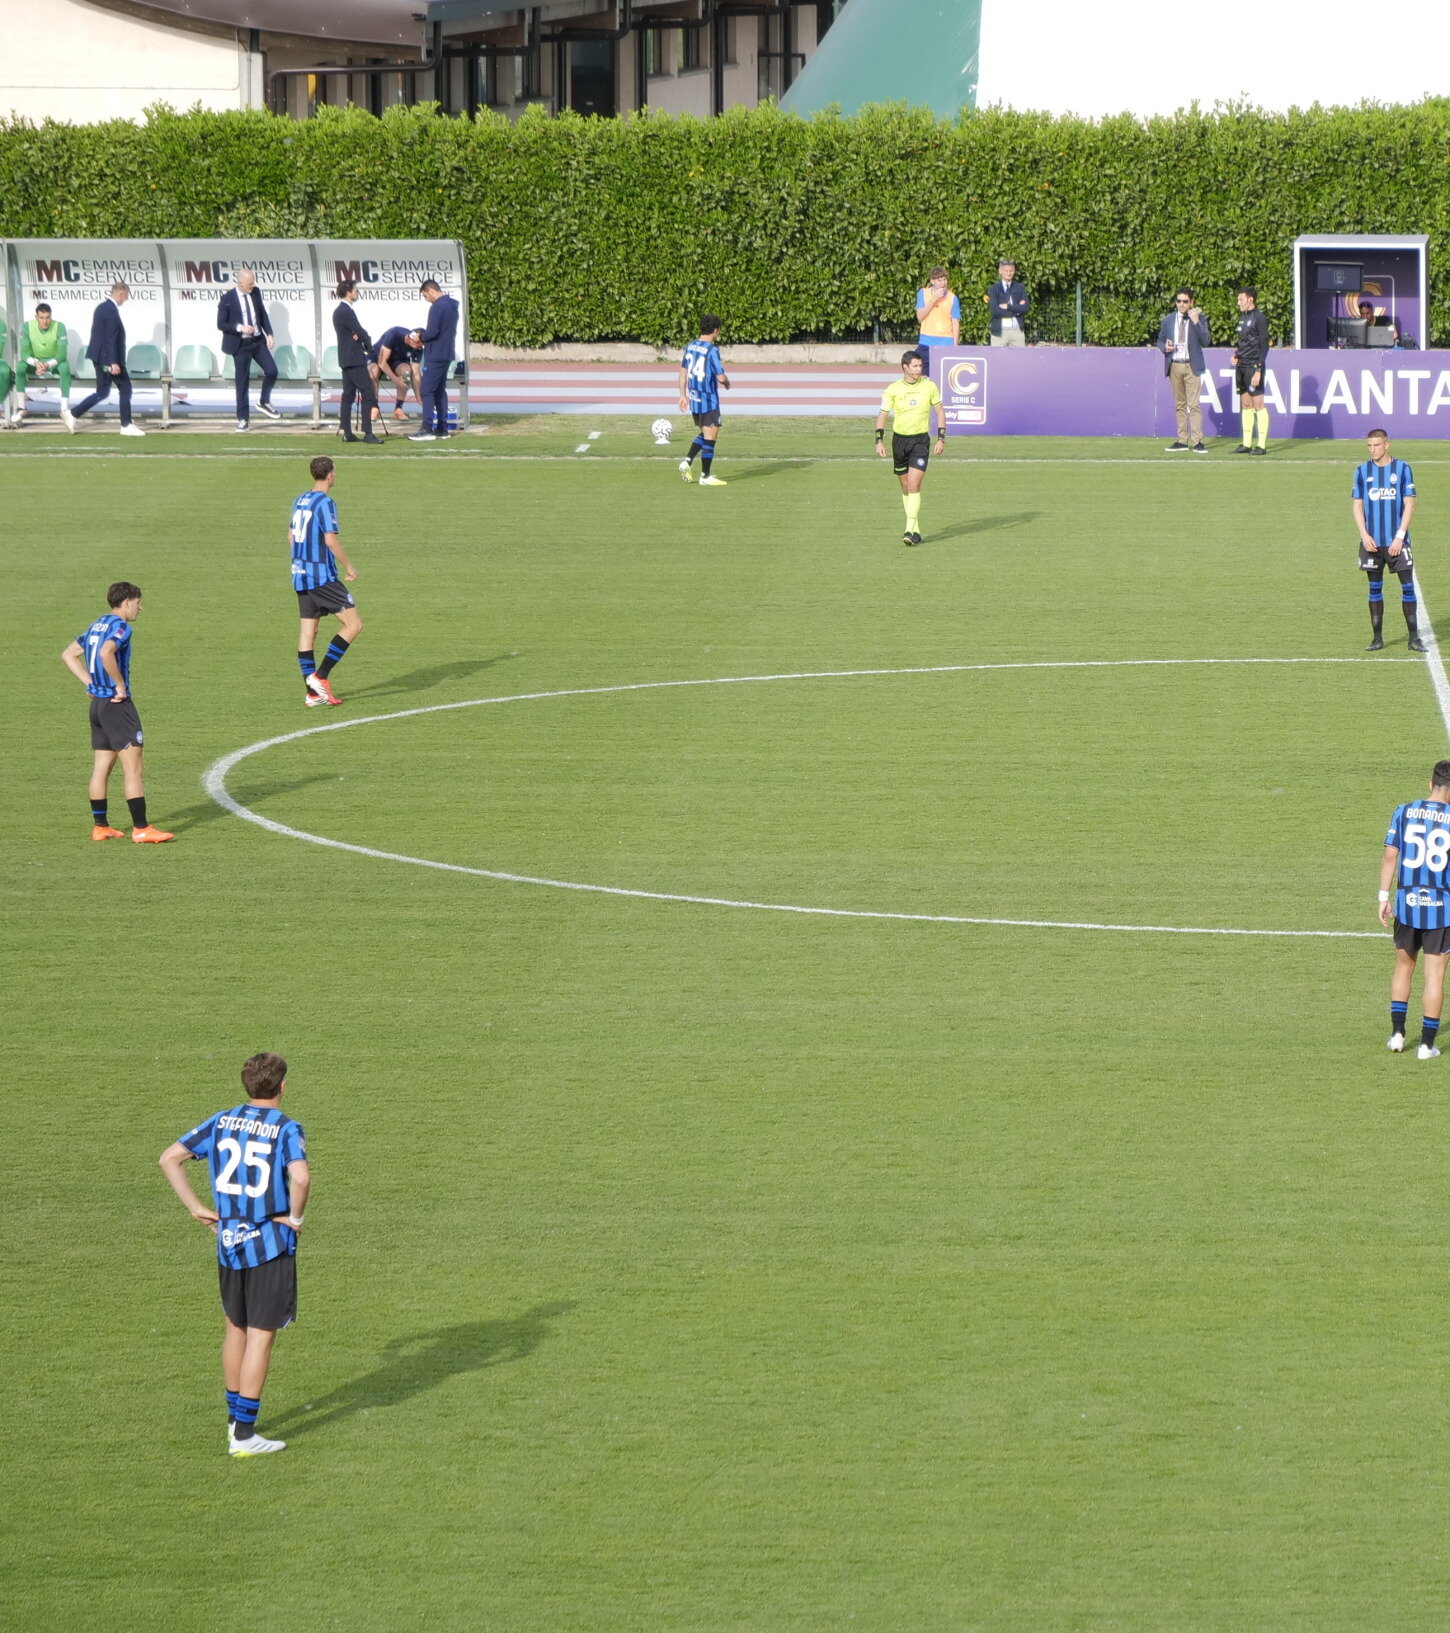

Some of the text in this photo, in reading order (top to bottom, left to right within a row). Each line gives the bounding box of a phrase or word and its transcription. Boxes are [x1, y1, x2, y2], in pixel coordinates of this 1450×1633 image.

[36, 259, 154, 283] MC EMMECI
[83, 270, 156, 284] SERVICE
[185, 260, 303, 283] MC EMMECI
[232, 271, 304, 284] SRVICE
[334, 260, 453, 283] MC EMMECI
[382, 271, 453, 284] SERVICE
[32, 290, 48, 300] MC
[50, 289, 101, 301] EMMECI
[181, 290, 197, 301] MC
[261, 291, 306, 301] ERVICE
[686, 353, 706, 382] 24
[951, 396, 976, 404] SERIE C
[1380, 488, 1396, 496] TAO
[88, 635, 100, 674] 7
[217, 1115, 281, 1139] STEFFANONI
[215, 1137, 272, 1199] 25
